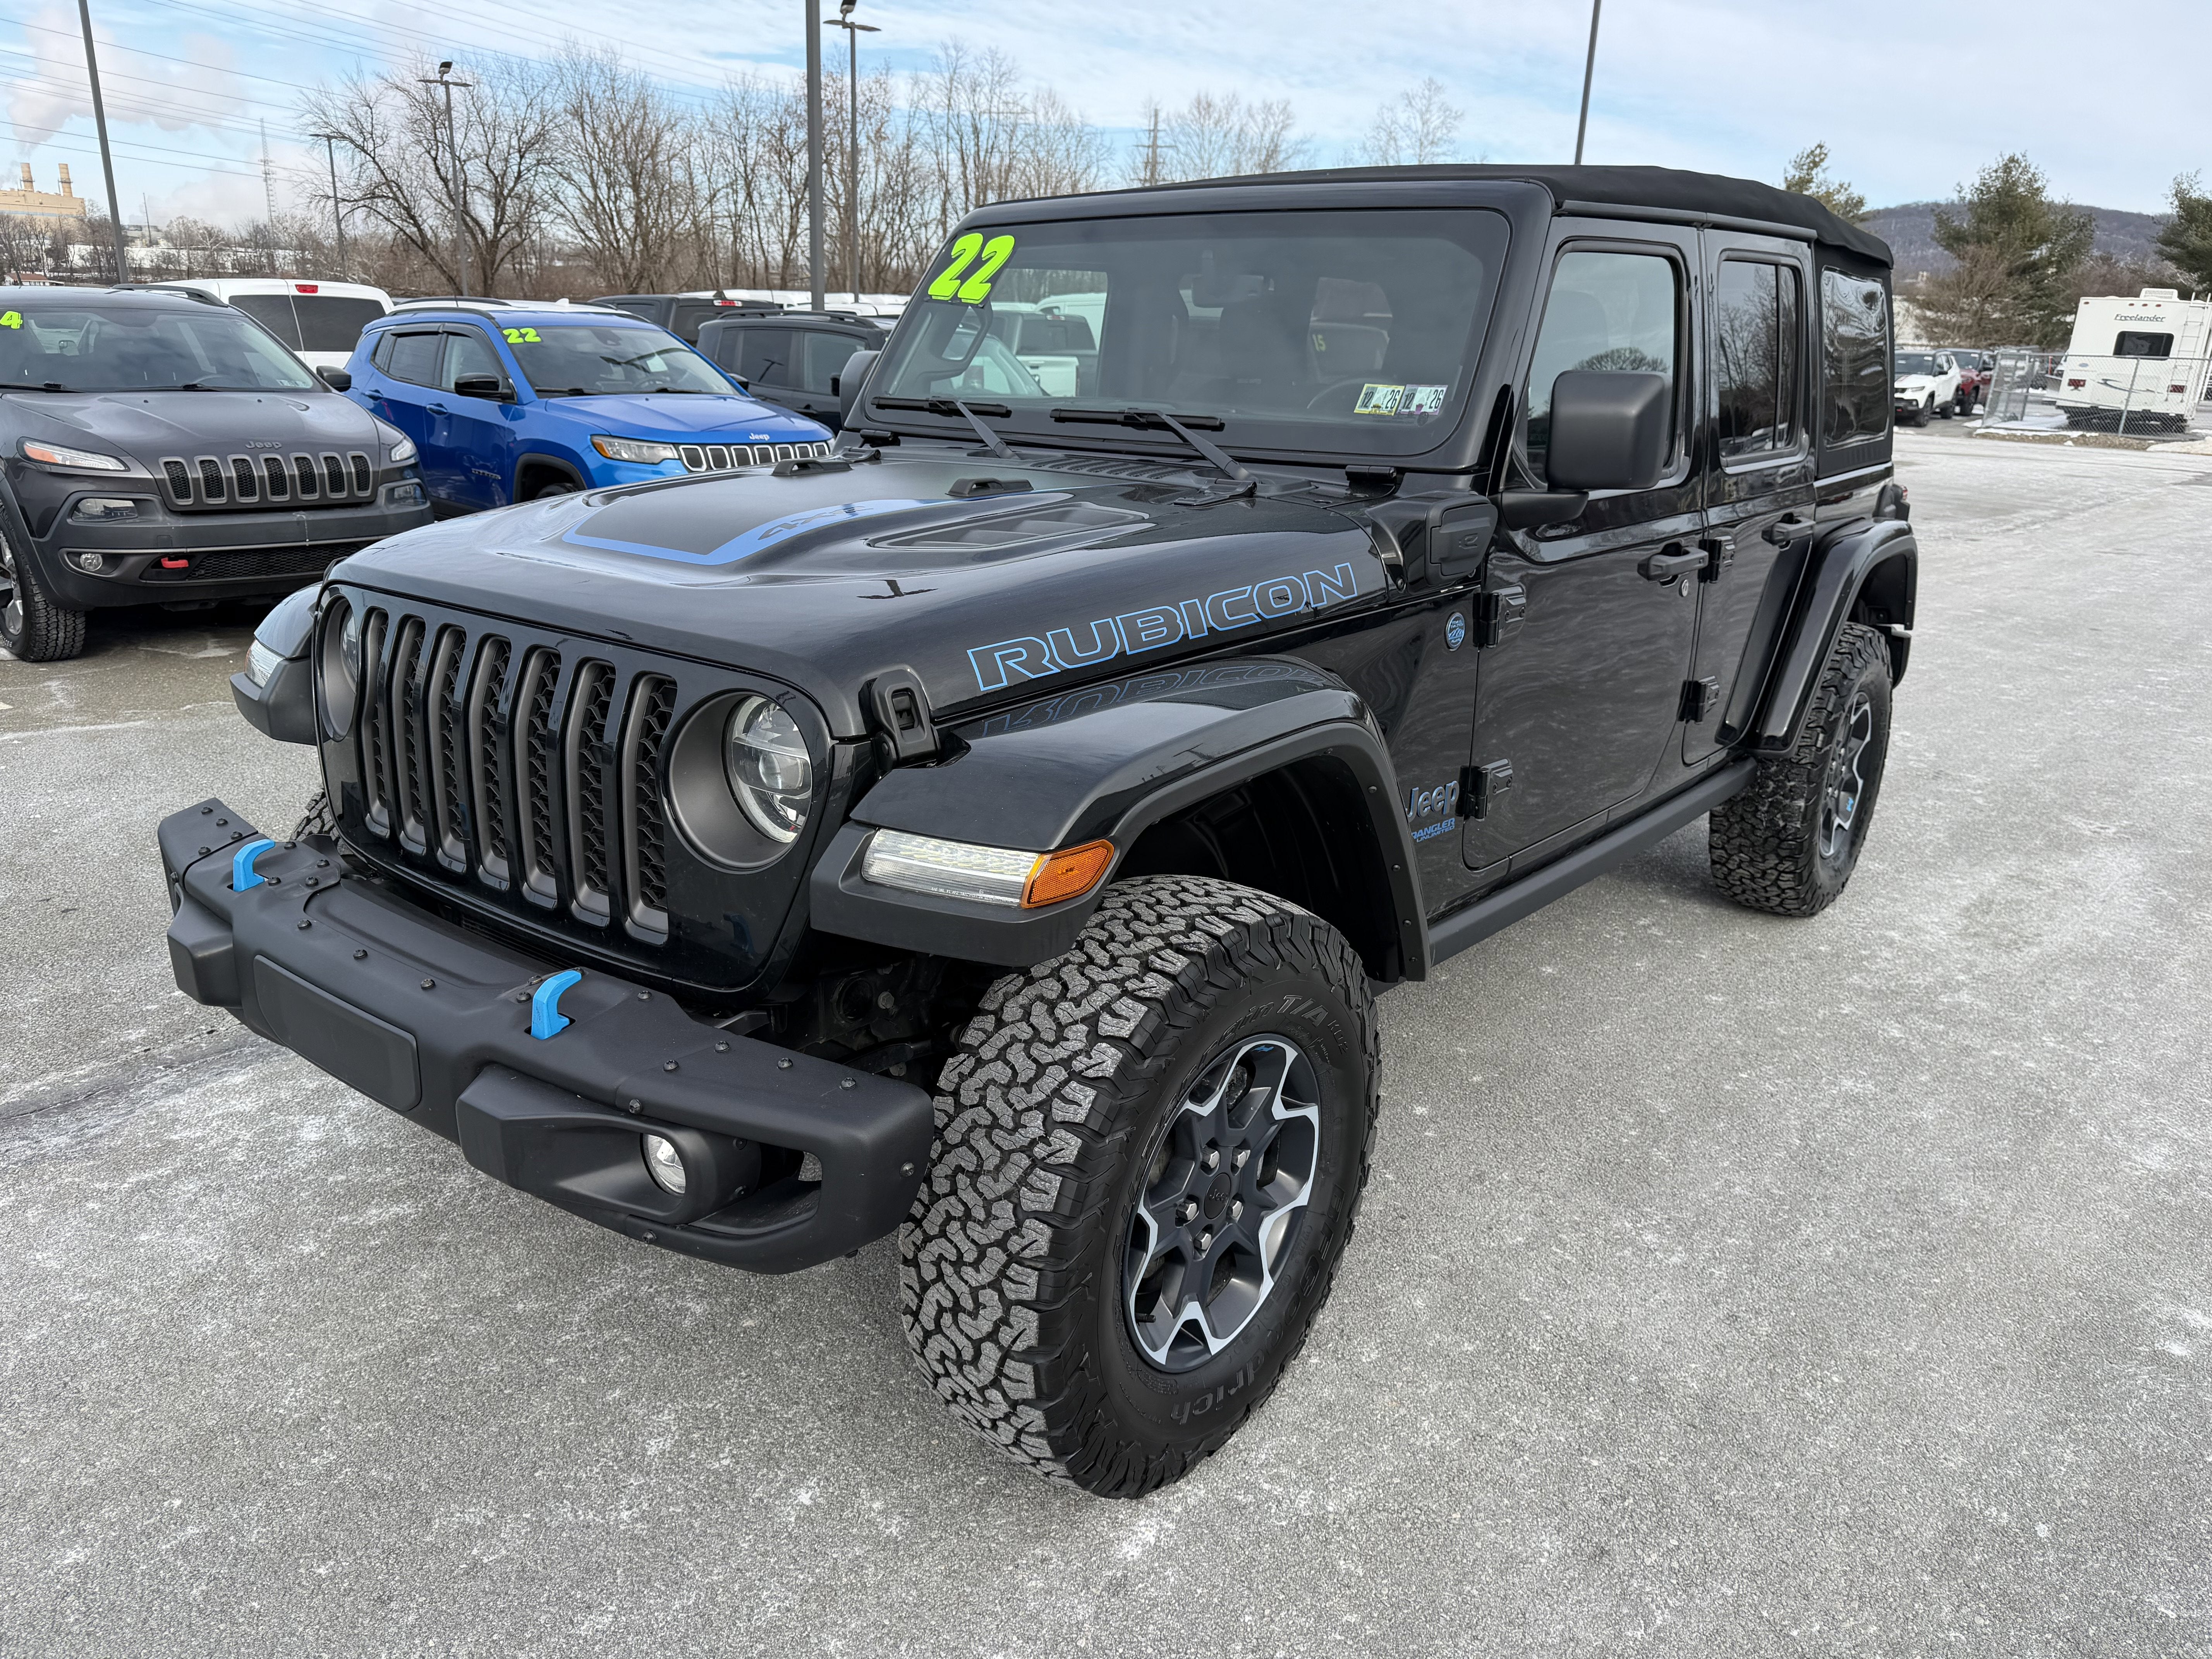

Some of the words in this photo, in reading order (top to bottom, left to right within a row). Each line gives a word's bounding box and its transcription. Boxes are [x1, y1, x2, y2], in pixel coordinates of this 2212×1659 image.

[927, 233, 1015, 304] 22
[0, 311, 23, 329] 4
[2114, 313, 2166, 322] Freelander
[503, 328, 541, 343] 22
[1361, 391, 1374, 409] 12
[1385, 389, 1400, 409] 26
[1402, 392, 1415, 409] 12
[1429, 389, 1444, 409] 26
[245, 440, 282, 450] Jeep
[749, 433, 770, 441] Jeep
[967, 562, 1357, 691] RUBICON
[1405, 781, 1460, 823] Jeep
[1412, 818, 1455, 840] RANGLER
